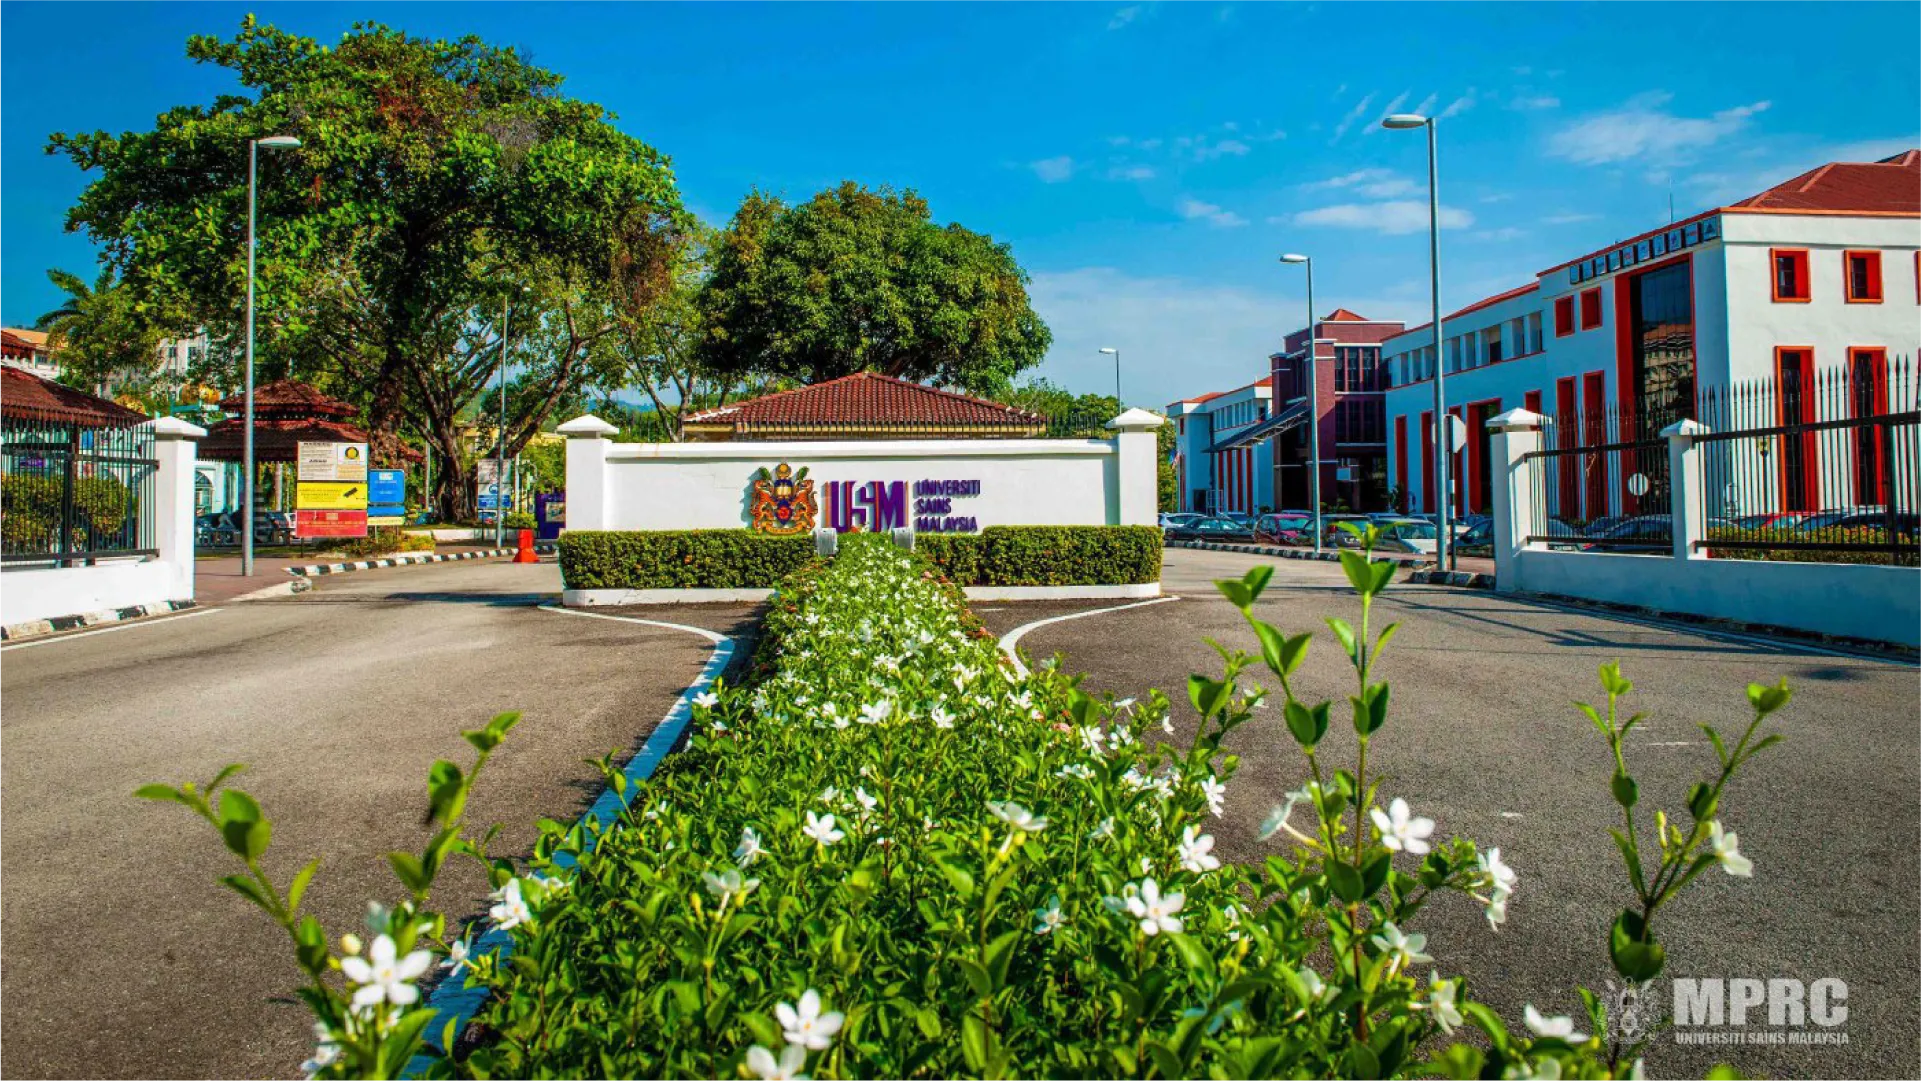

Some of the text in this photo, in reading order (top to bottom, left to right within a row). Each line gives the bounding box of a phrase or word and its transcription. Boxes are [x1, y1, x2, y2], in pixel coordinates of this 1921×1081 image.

[915, 479, 981, 496] UNIVERSITI
[825, 480, 908, 533] USM
[916, 498, 952, 514] SAINS
[916, 516, 978, 533] MALAYSIA
